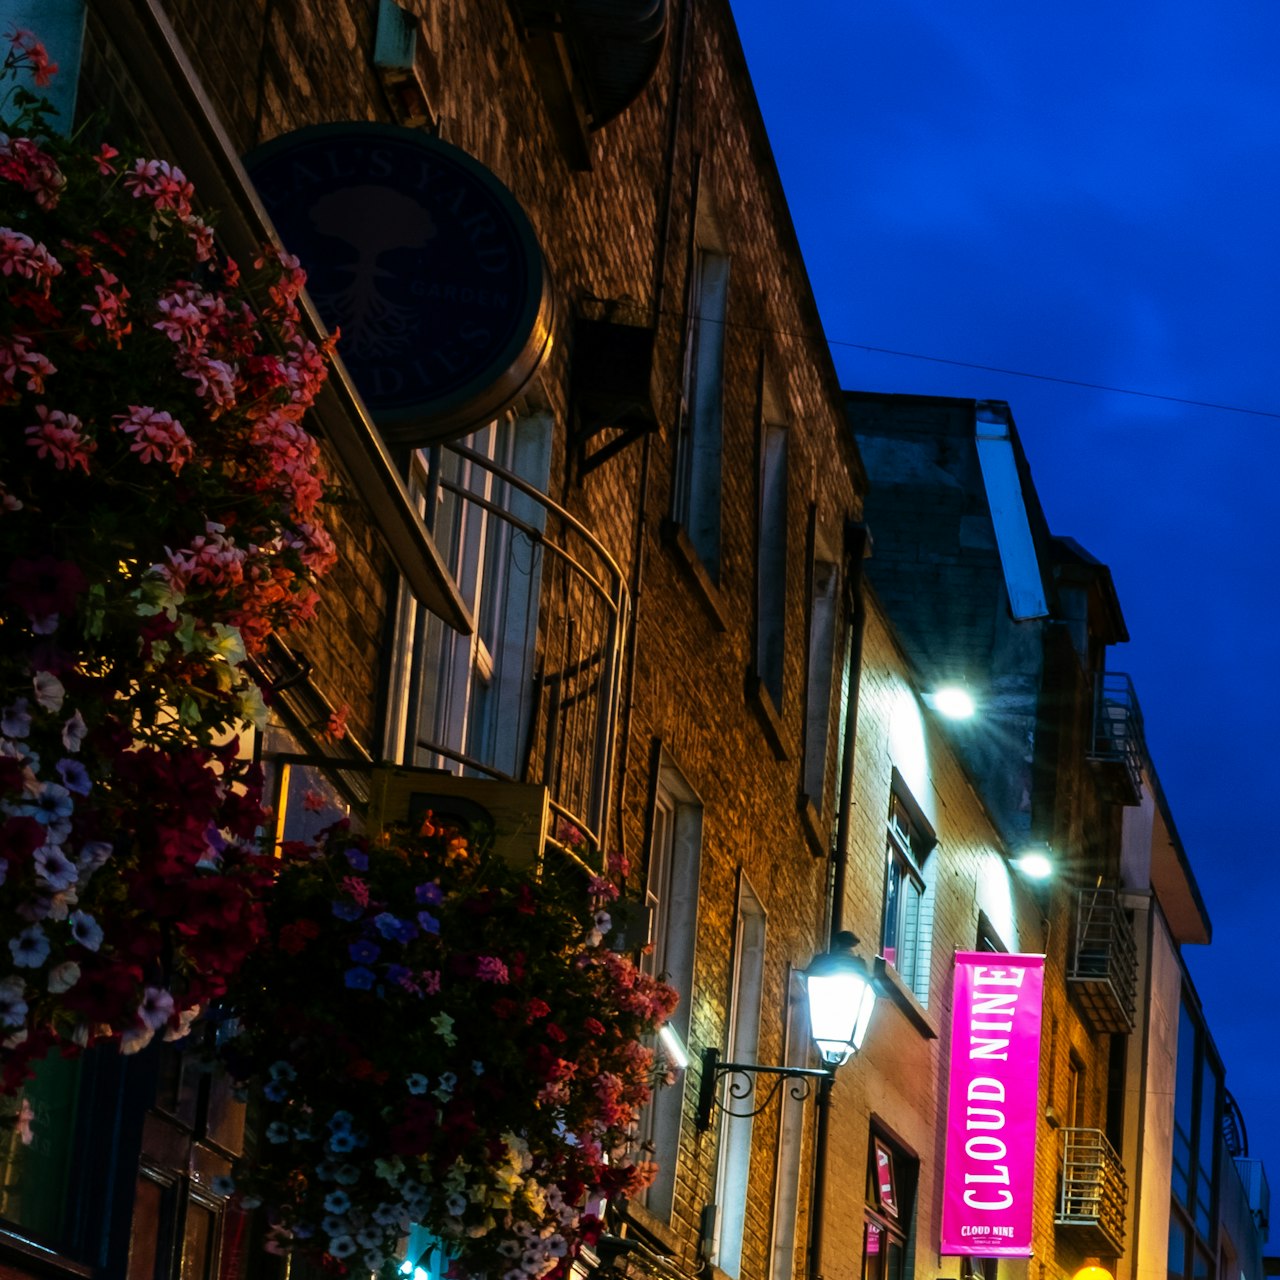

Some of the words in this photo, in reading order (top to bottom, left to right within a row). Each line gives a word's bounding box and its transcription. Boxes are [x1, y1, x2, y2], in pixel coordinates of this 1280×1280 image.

[409, 280, 509, 309] GARDEN
[969, 966, 1025, 1061] NINE
[962, 1075, 1014, 1212] CLOUD
[961, 1225, 990, 1237] CLOUD
[992, 1226, 1015, 1238] NINE
